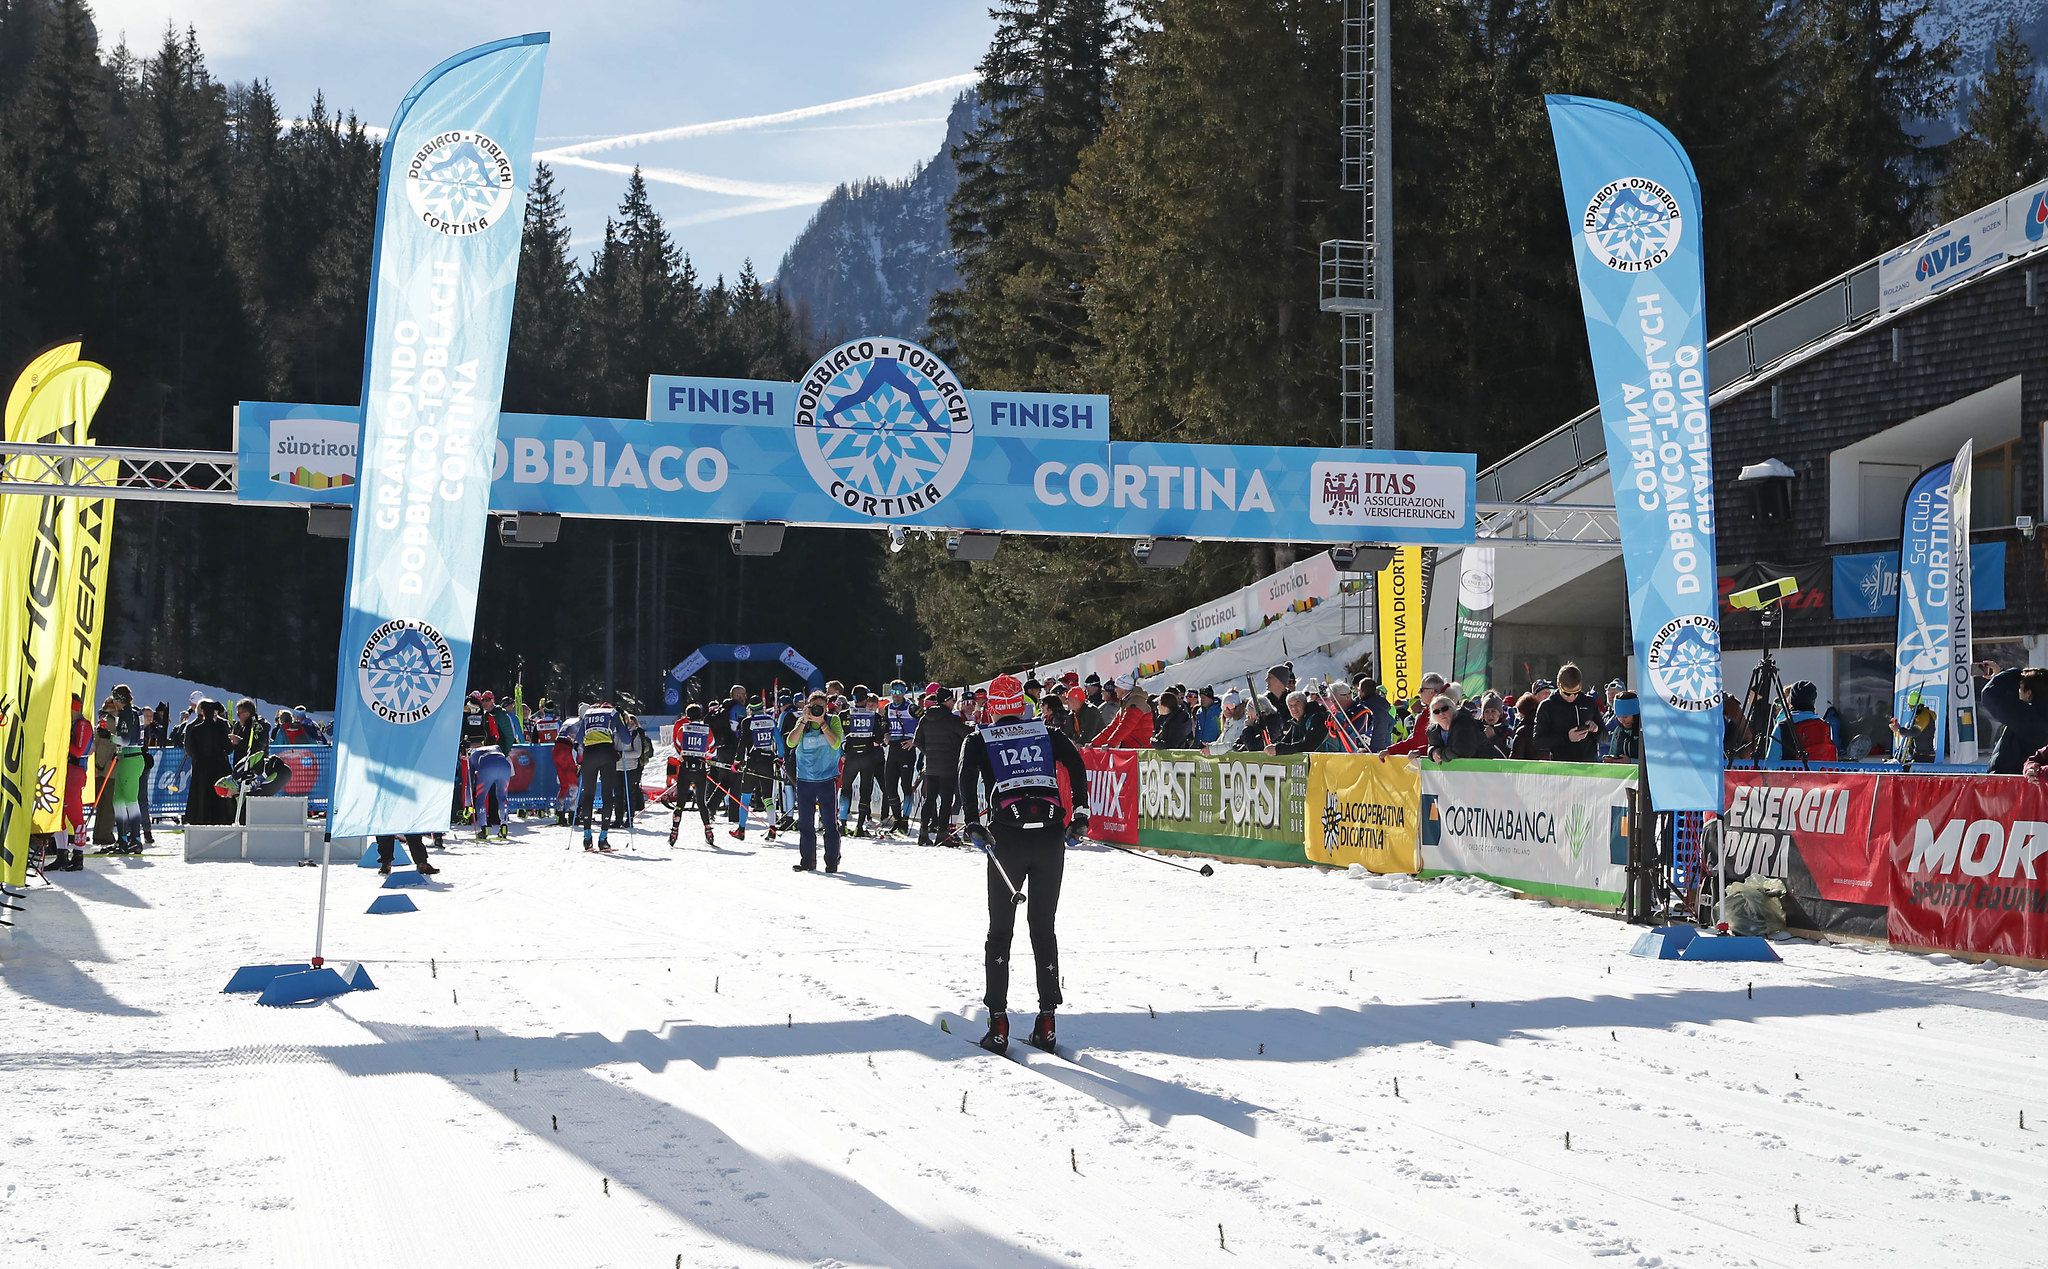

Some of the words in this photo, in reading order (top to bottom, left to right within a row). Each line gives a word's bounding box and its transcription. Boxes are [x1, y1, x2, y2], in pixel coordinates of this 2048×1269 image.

[408, 131, 461, 180] DOBBIACO
[474, 133, 513, 183] TOBLACH
[422, 210, 489, 235] CORTINA
[1915, 234, 1972, 282] AVIS
[1883, 281, 1910, 297] BOLZANO
[667, 386, 776, 417] FINISH
[796, 341, 875, 427] DOBBIACO
[896, 342, 970, 424] TOBLACH
[375, 319, 421, 531] GRANFONDO
[438, 357, 480, 502] CORTINA
[990, 401, 1094, 430] FINISH
[491, 437, 729, 493] BBIACO
[1364, 472, 1416, 496] ITAS
[829, 479, 943, 518] CORTINA
[1033, 460, 1276, 514] CORTINA
[1363, 494, 1446, 509] ASSICURAZIONI
[1363, 506, 1457, 521] VERSICHERUNGEN
[1912, 491, 1932, 534] Club
[1910, 538, 1928, 565] Sci
[1926, 483, 1951, 608] CORTINA
[1953, 516, 1970, 701] CORTINABANCA
[360, 619, 406, 669] DOBBIACO
[417, 621, 453, 670] TOBLACH
[371, 700, 432, 724] CORTINA
[588, 715, 605, 724] 1196
[1005, 724, 1024, 733] ITAS
[687, 736, 702, 746] 1114
[757, 732, 772, 742] 1323
[1000, 745, 1044, 767] 1242
[1138, 758, 1196, 822] FORST
[1217, 759, 1287, 830] FORST
[1290, 800, 1303, 815] BEE
[1290, 818, 1303, 833] BIE
[1445, 805, 1557, 845] CORTINABANCA
[1730, 785, 1851, 835] ENERGIA
[1724, 830, 1791, 879] PURA
[1906, 817, 2048, 881] MOR
